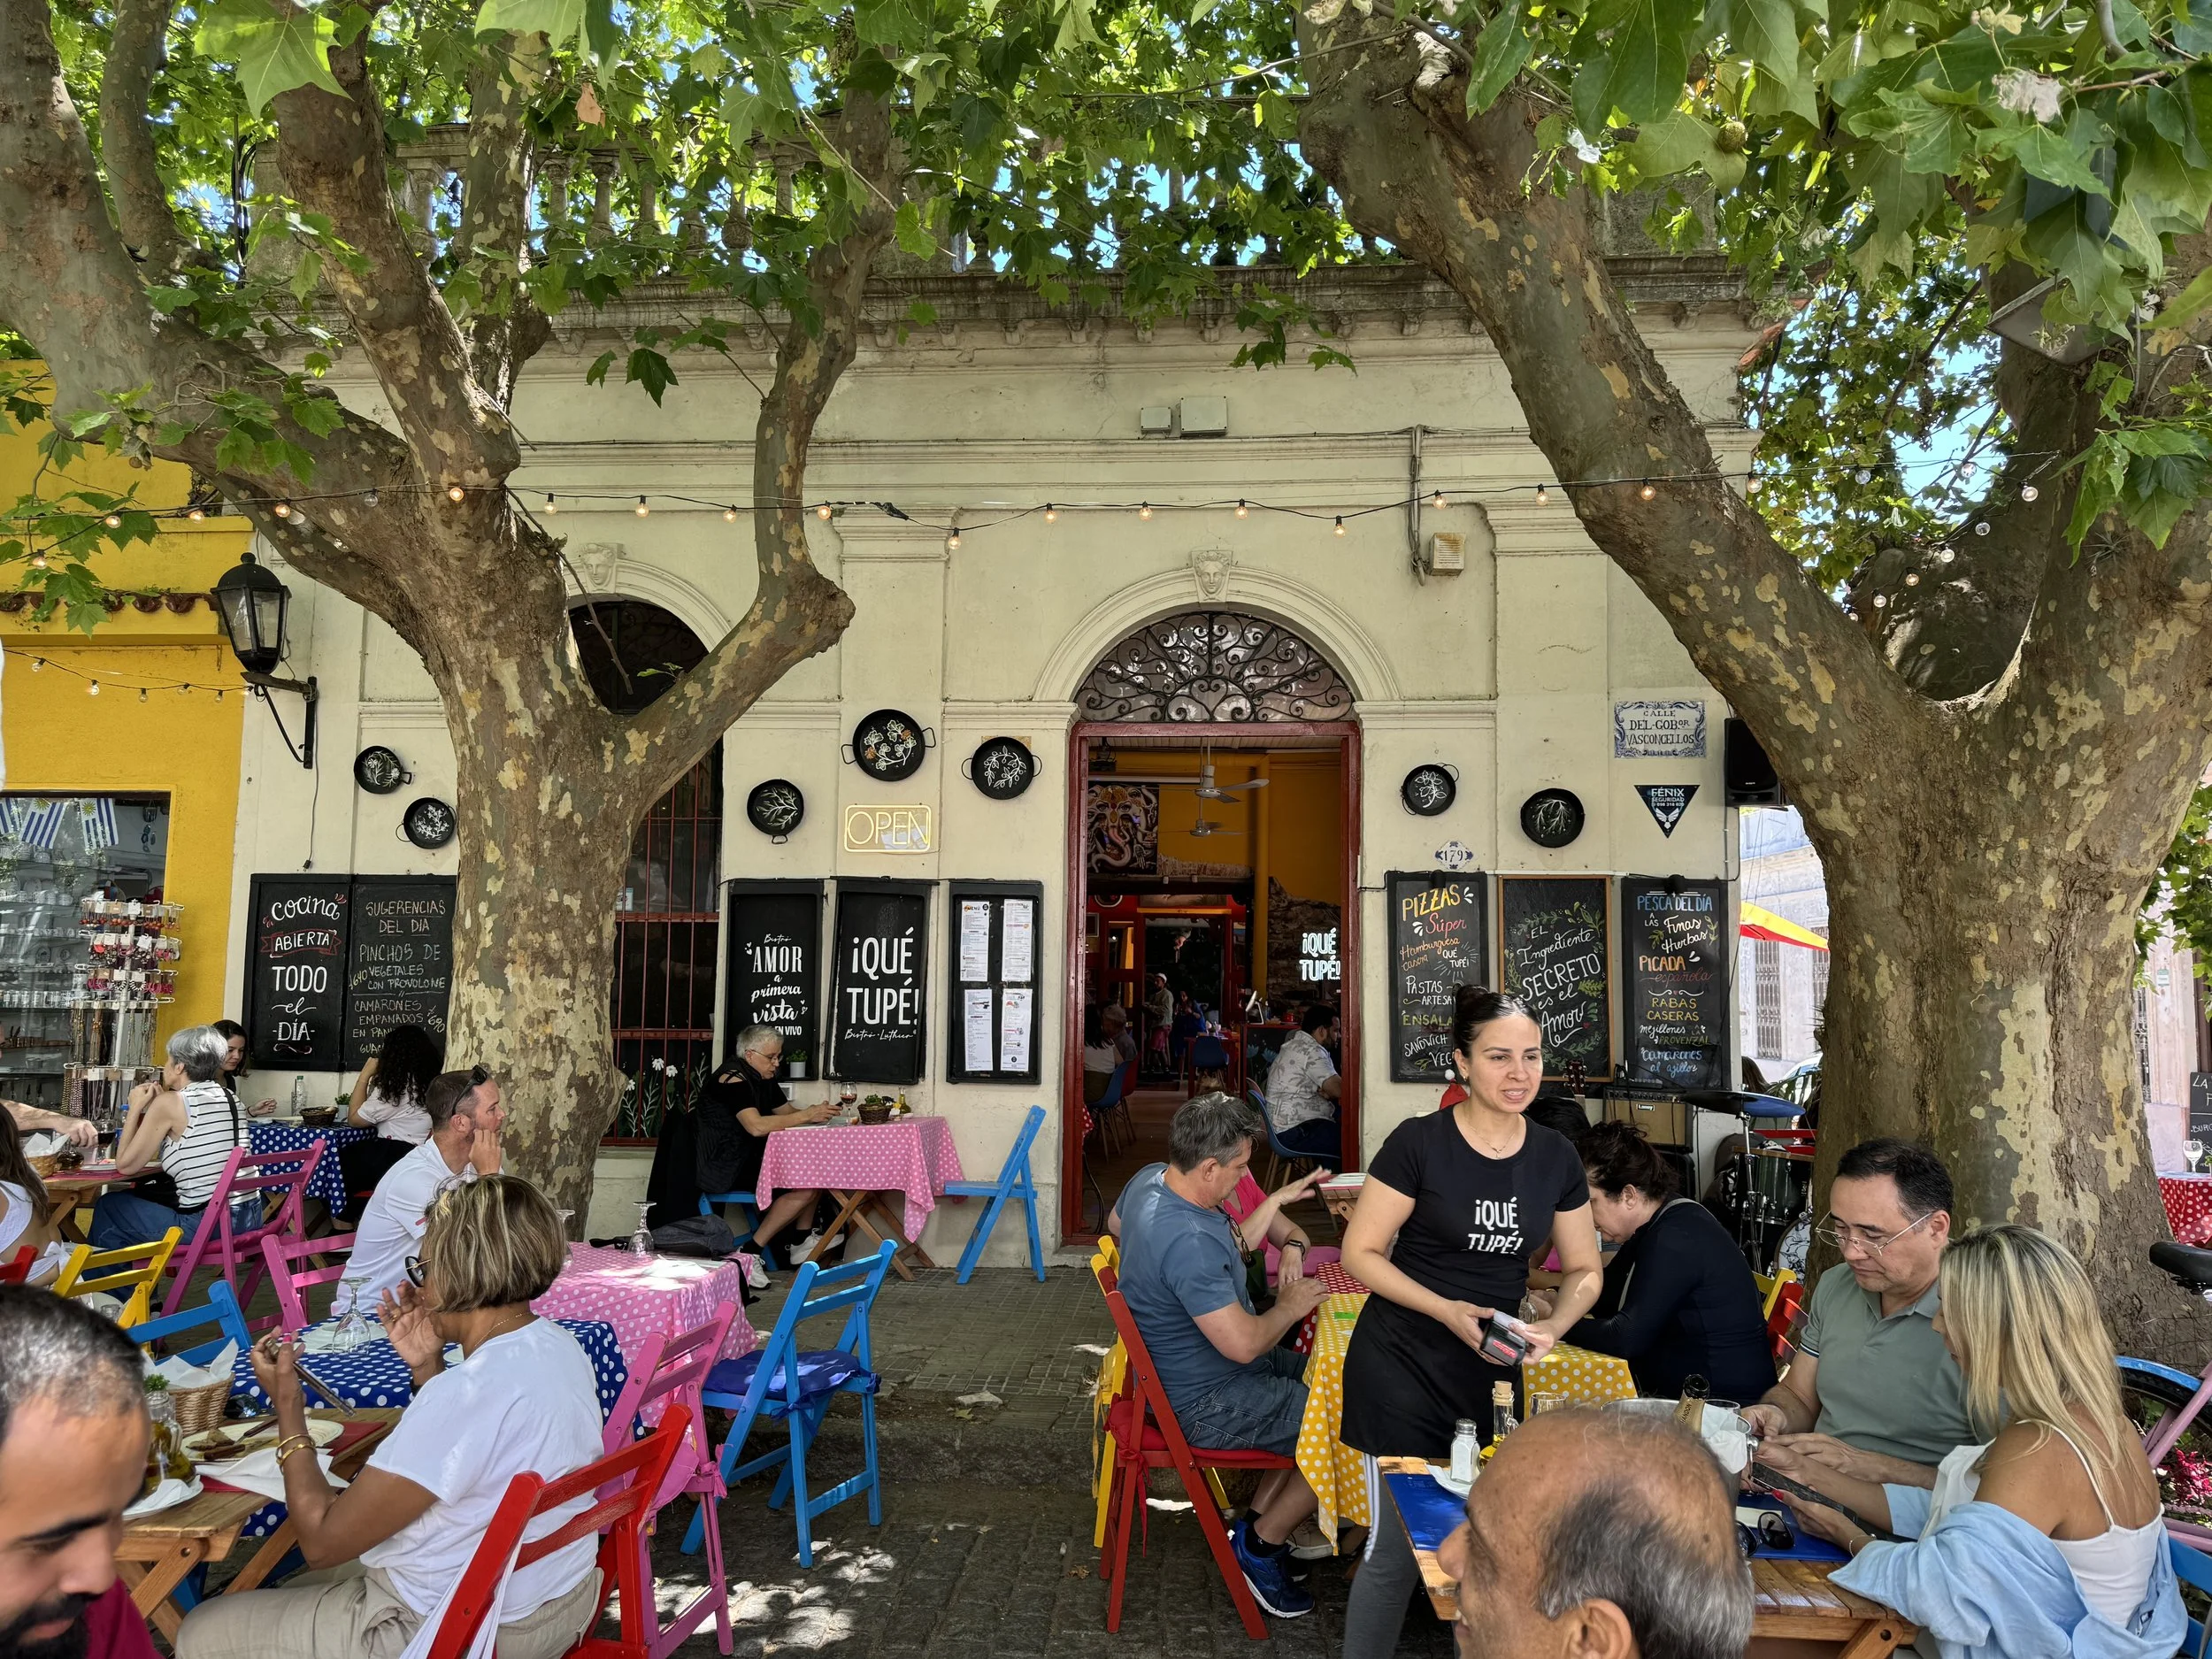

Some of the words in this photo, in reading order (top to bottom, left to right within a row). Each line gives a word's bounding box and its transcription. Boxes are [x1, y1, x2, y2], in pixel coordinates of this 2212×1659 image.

[1626, 733, 1694, 747] VASCONCELLOS
[1651, 787, 1685, 797] FÉNIX
[848, 811, 929, 844] OPEN
[1444, 850, 1463, 863] 179
[365, 900, 446, 916] SUGERENCIAS
[1402, 884, 1461, 921] PIZZAS
[1637, 895, 1672, 911] PESCA
[1675, 896, 1694, 911] DEL
[1695, 894, 1713, 911] DÍA
[380, 919, 403, 933] DEL
[411, 918, 430, 933] DIA
[1425, 912, 1467, 939] Súper
[1531, 926, 1548, 939] EL
[1663, 915, 1701, 933] Finas
[1302, 927, 1336, 957] ¡QUÉ
[1400, 937, 1461, 961] Hamburguesa
[1517, 927, 1595, 971] Ingrediente
[1661, 929, 1709, 954] Hierbas
[359, 943, 413, 963] PINCHOS
[423, 943, 441, 961] DE
[752, 946, 803, 972] AMOR
[852, 926, 914, 980] ¡QUÉ
[369, 964, 425, 977] VEGETALES
[1299, 955, 1341, 980] TUPÉ!
[1639, 956, 1686, 972] PICADA
[272, 965, 327, 993] TODO
[368, 980, 384, 990] CON
[388, 977, 446, 988] PROVOLONE
[774, 974, 783, 983] a
[1405, 975, 1443, 995] PASTAS
[1519, 953, 1601, 1001] SECRETO
[1649, 967, 1714, 987] española
[751, 984, 802, 1003] primera
[846, 977, 919, 1025] TUPÉ!
[1421, 995, 1454, 1005] ARTESA
[1538, 996, 1554, 1010] es
[1559, 983, 1578, 1001] el
[278, 997, 312, 1015] el
[354, 998, 422, 1012] CAMARONES
[753, 998, 798, 1024] vista
[1652, 997, 1697, 1009] RABAS
[359, 1013, 424, 1025] EMPANADOS
[1402, 1015, 1453, 1026] ENSALA
[1541, 1001, 1586, 1047] Amor
[1647, 1010, 1700, 1021] CASERAS
[352, 1029, 365, 1038] EN
[371, 1027, 393, 1038] PAN
[785, 1026, 803, 1036] VIVO
[359, 1043, 384, 1054] GUAC
[1404, 1033, 1448, 1057] SANDWICH
[1659, 1035, 1711, 1046] PROVENZAL
[1428, 1052, 1453, 1067] VEG
[1650, 1062, 1661, 1072] al
[1667, 1061, 1693, 1079] ajillo
[2193, 1075, 2208, 1089] LA
[1475, 1196, 1519, 1231] ¡QUÉ
[1468, 1230, 1524, 1255] TUPÉ!
